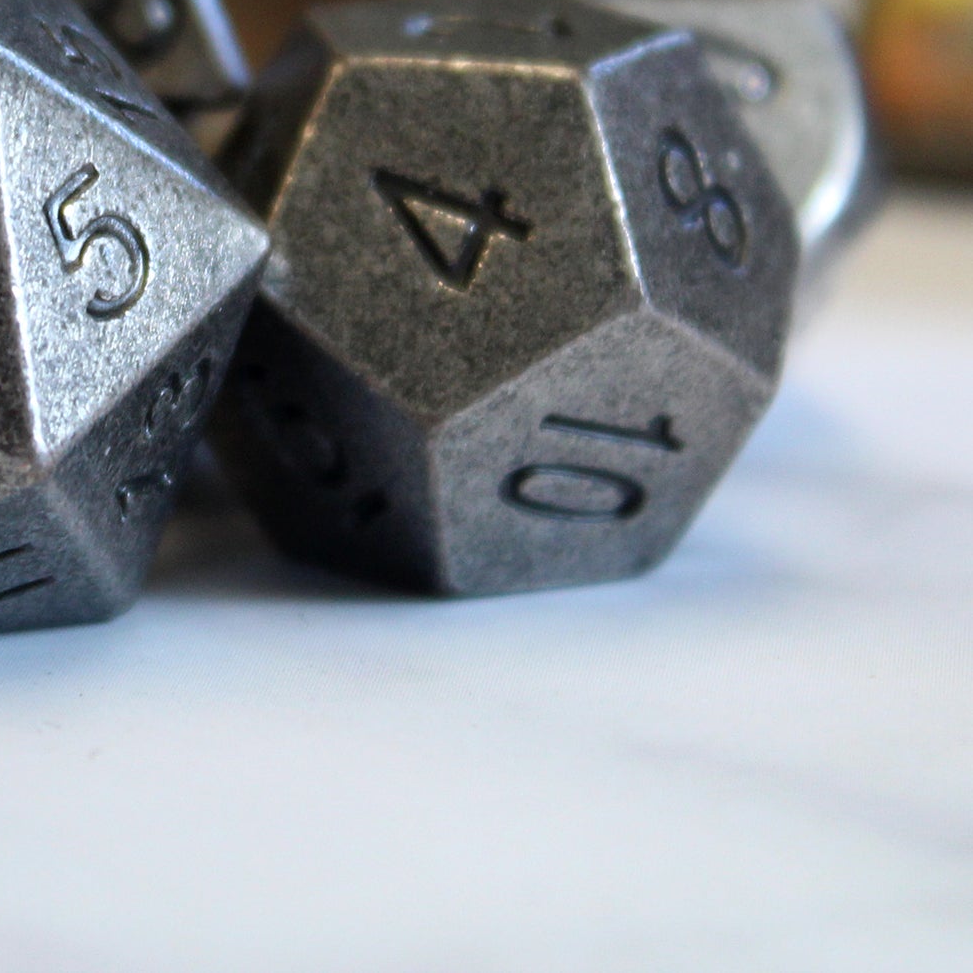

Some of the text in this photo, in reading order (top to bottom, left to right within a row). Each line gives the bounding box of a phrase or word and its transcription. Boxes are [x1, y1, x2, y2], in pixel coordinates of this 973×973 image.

[42, 162, 150, 319] 5
[370, 165, 535, 291] 4
[658, 126, 749, 277] 8
[498, 411, 685, 519] 10
